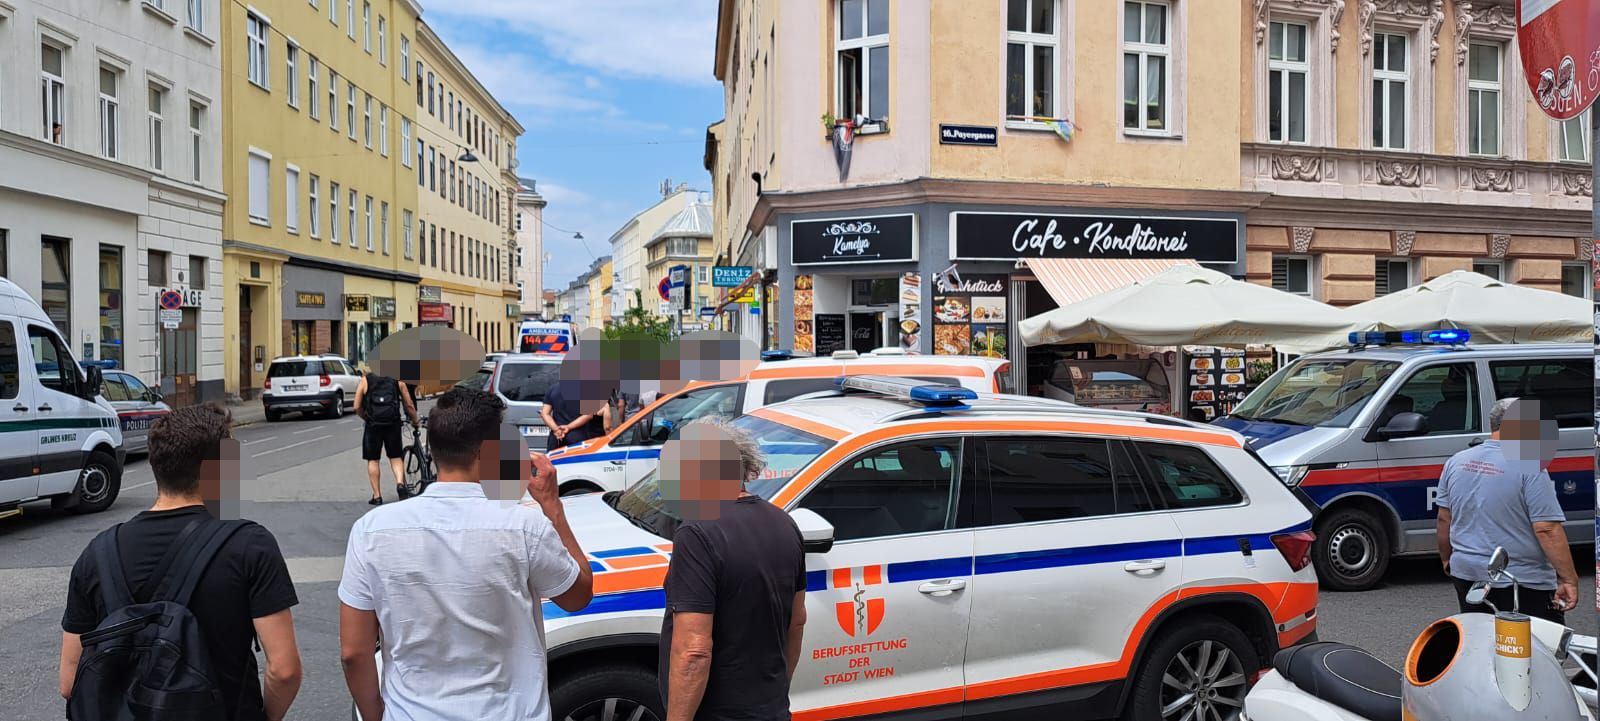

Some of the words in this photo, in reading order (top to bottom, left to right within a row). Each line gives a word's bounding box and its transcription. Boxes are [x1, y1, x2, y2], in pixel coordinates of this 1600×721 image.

[833, 236, 870, 255] Kamelya
[1012, 219, 1066, 256] Cafe
[1083, 222, 1188, 256] Konditorei
[524, 336, 541, 344] 144
[813, 639, 907, 659] BERUFSRETTUNG
[848, 657, 871, 669] DER
[823, 672, 859, 685] STADT
[864, 667, 894, 679] WIEN
